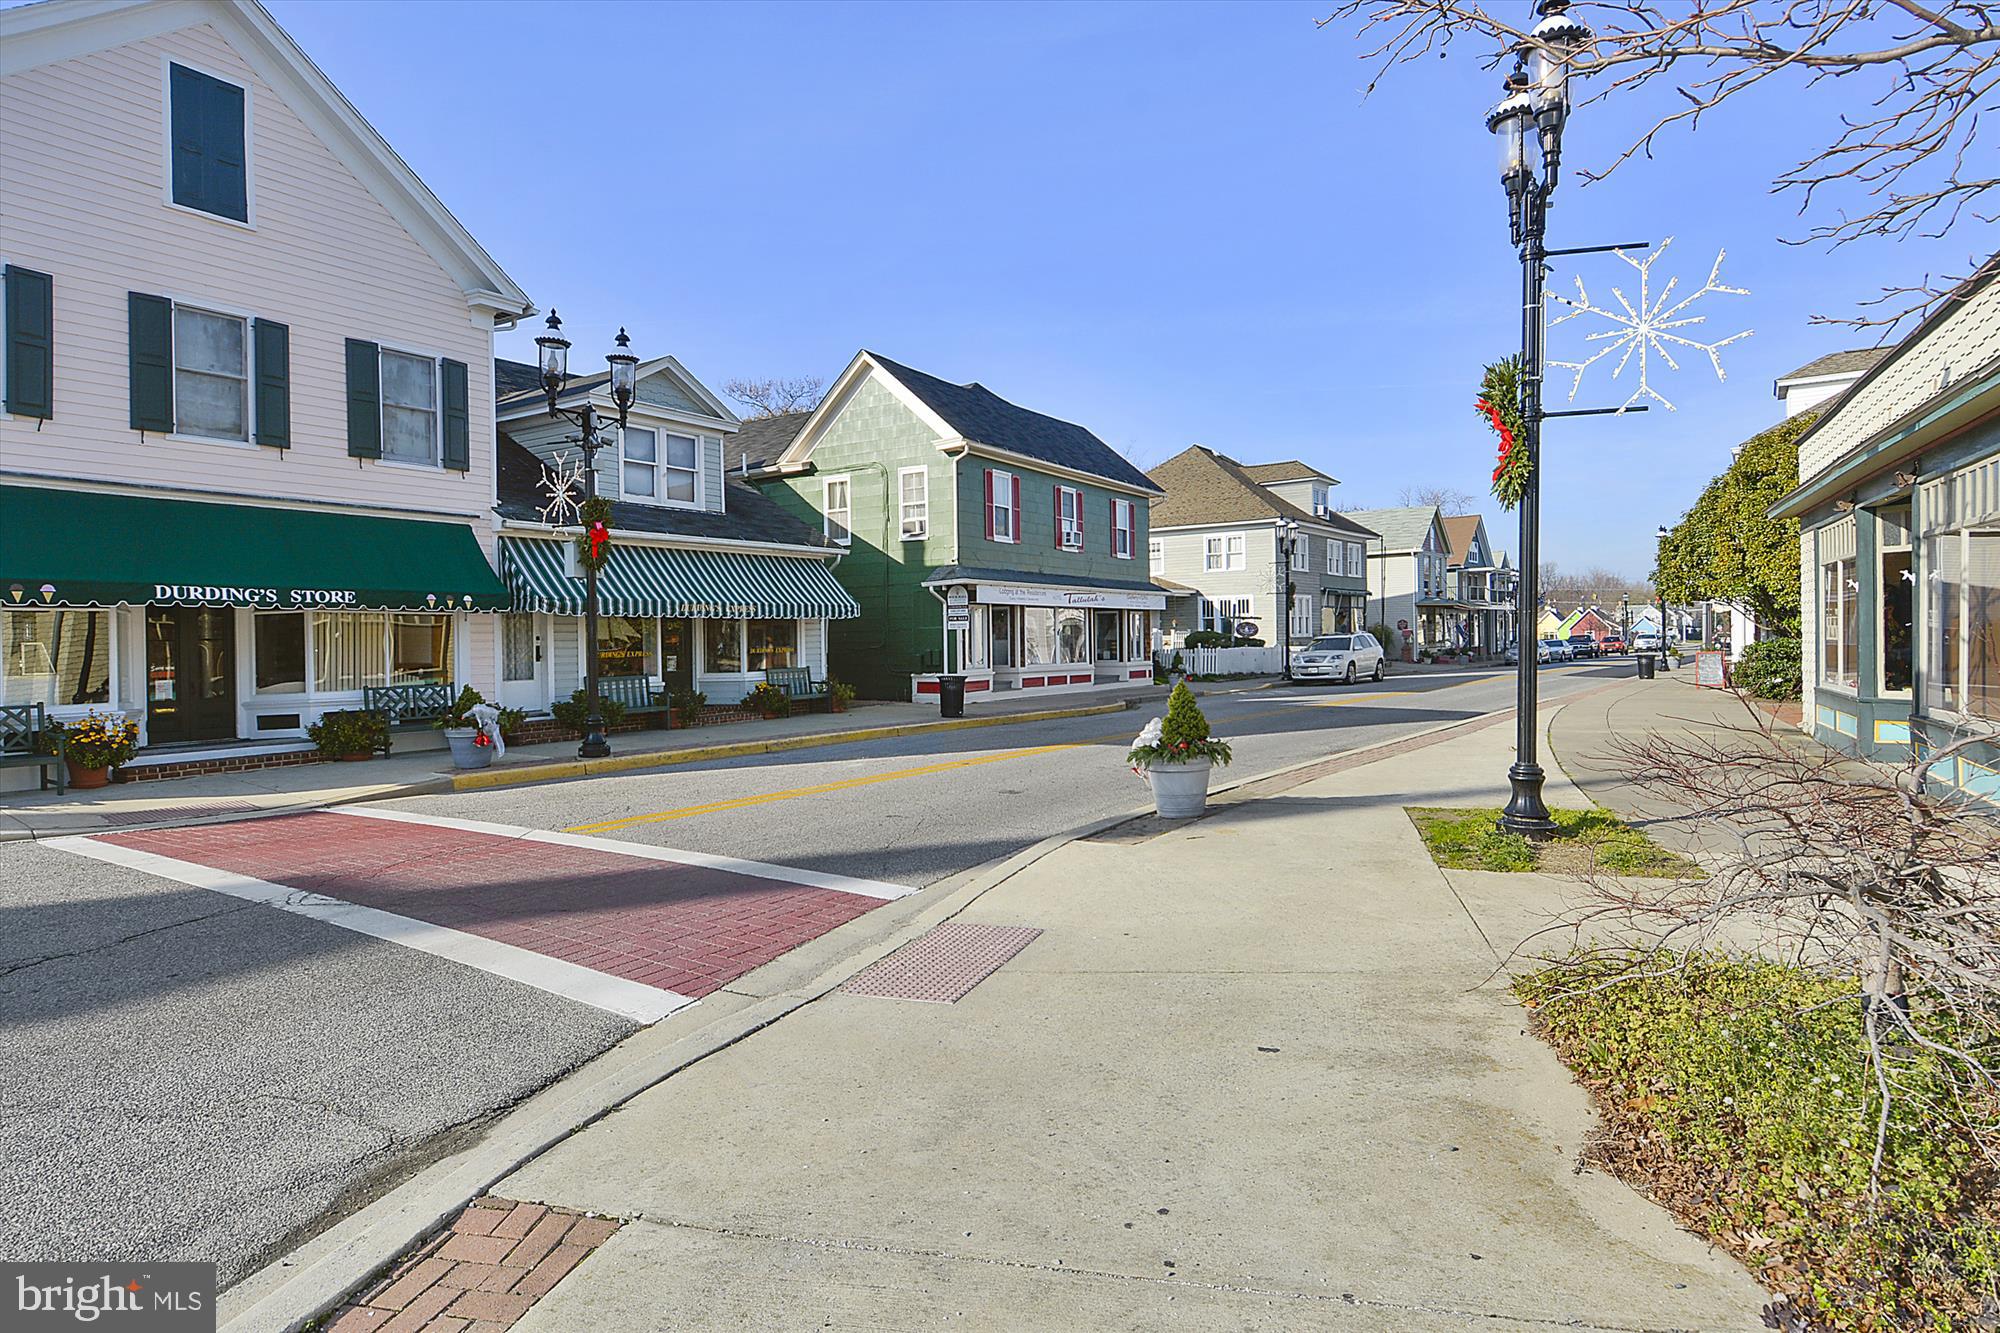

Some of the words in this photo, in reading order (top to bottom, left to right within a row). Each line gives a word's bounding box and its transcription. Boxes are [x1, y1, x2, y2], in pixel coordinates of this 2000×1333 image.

[154, 584, 277, 603] DURDING'S
[290, 588, 356, 605] STORE
[1064, 592, 1106, 604] Tallulah's
